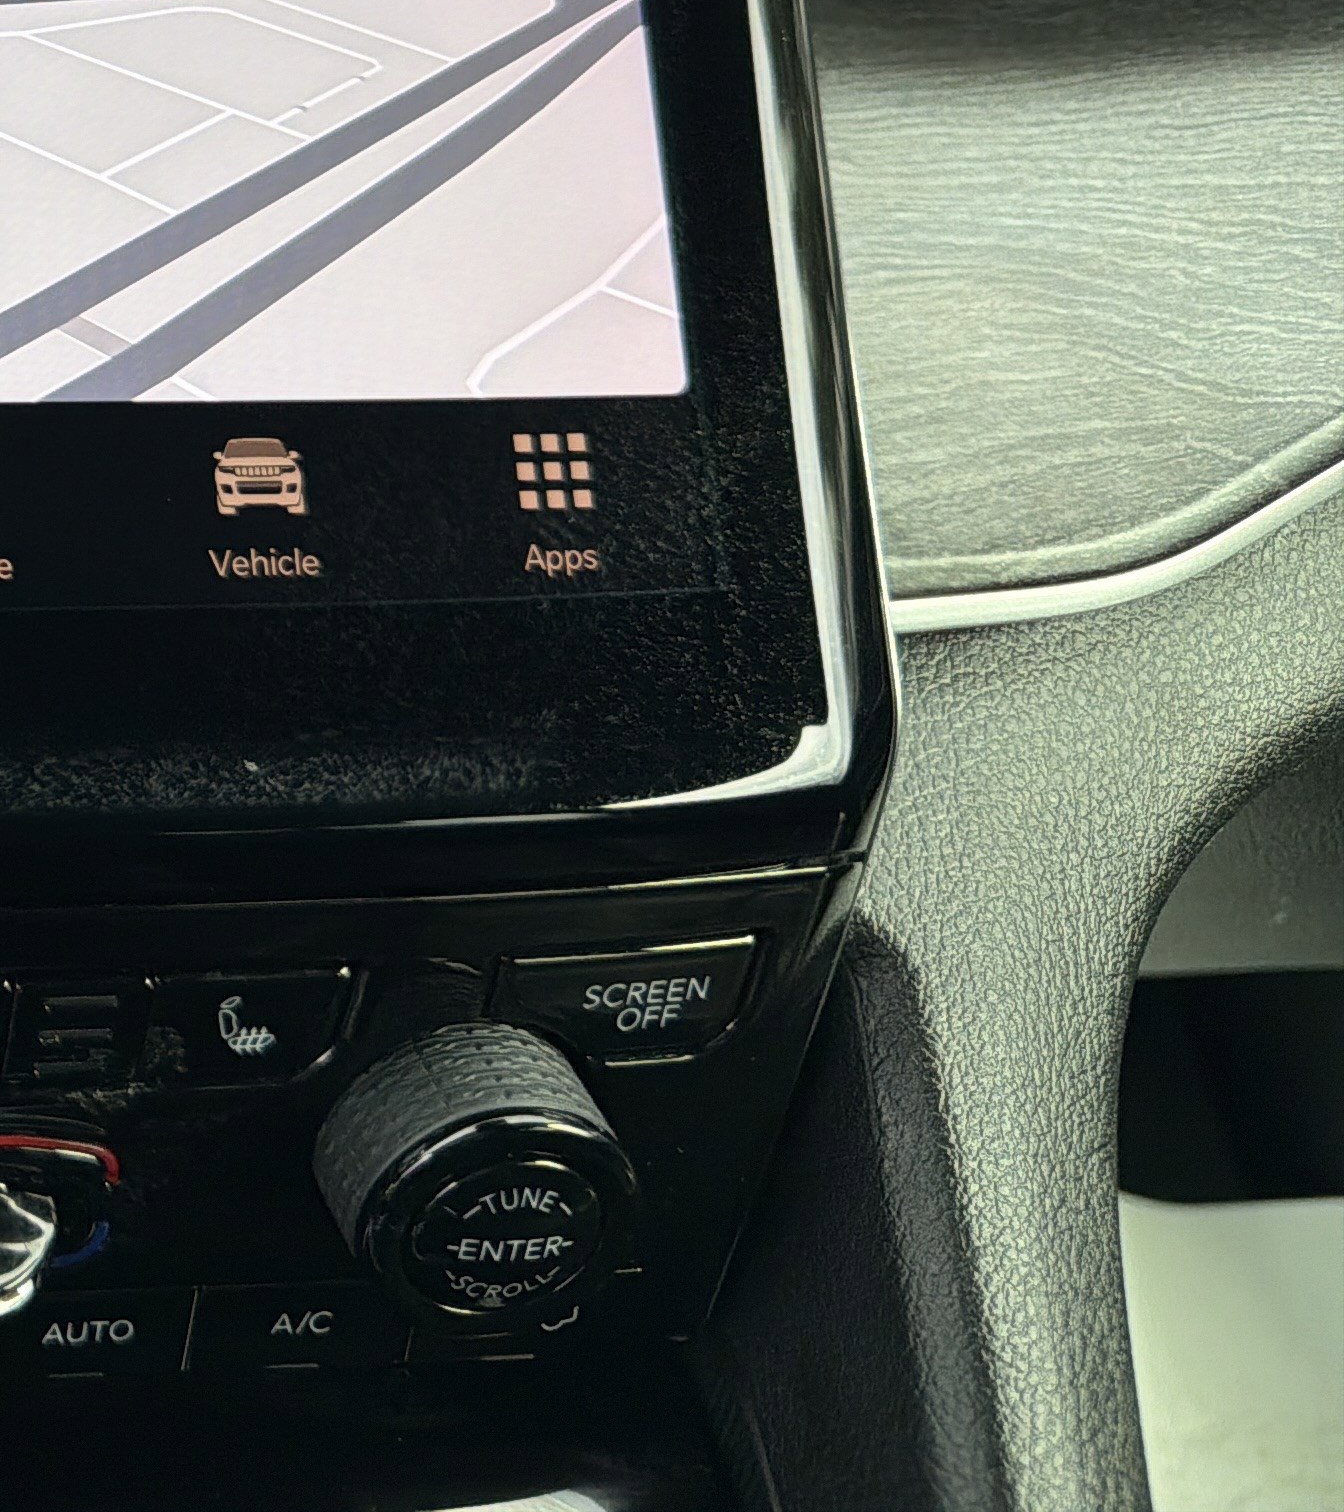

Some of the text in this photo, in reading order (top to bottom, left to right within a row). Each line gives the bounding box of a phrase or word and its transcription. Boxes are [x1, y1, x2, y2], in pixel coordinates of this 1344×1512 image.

[207, 547, 322, 578] Vehicle
[524, 543, 600, 574] Apps
[583, 976, 711, 1008] SCREEN
[616, 1004, 682, 1032] OFF
[478, 1187, 559, 1215] TUNE
[450, 1272, 554, 1299] SCROLL
[41, 1318, 135, 1348] AUTO
[271, 1310, 334, 1337] A/C
